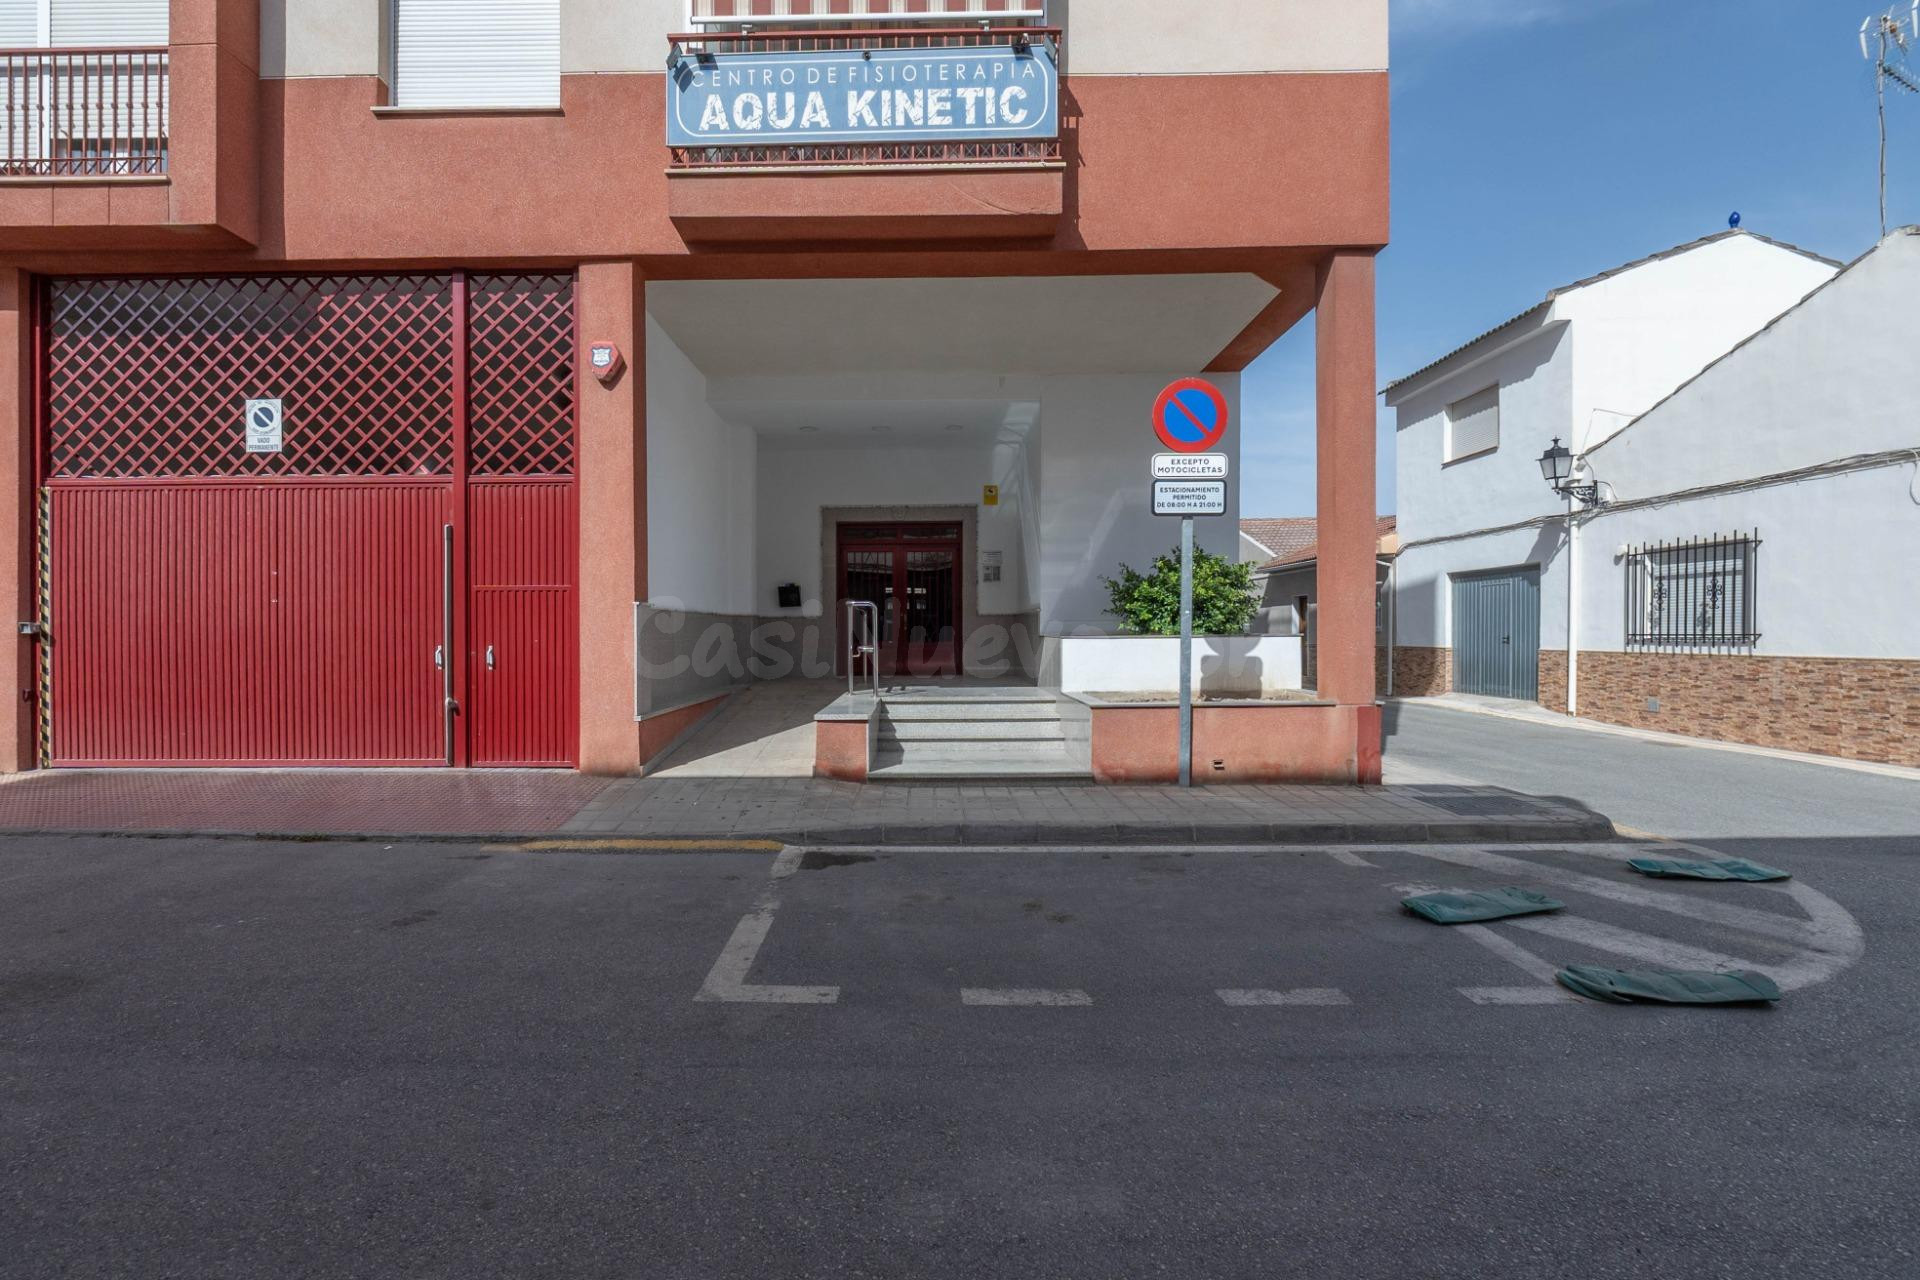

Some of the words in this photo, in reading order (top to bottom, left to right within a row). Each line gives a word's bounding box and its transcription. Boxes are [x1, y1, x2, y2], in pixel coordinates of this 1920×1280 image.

[692, 68, 795, 87] CENTRO
[807, 67, 837, 84] DE
[849, 62, 1035, 83] FISIOTERAPIA
[698, 92, 831, 131] AQUA
[847, 85, 1029, 128] KINETIC
[1157, 466, 1223, 474] MOTOCICLETAS
